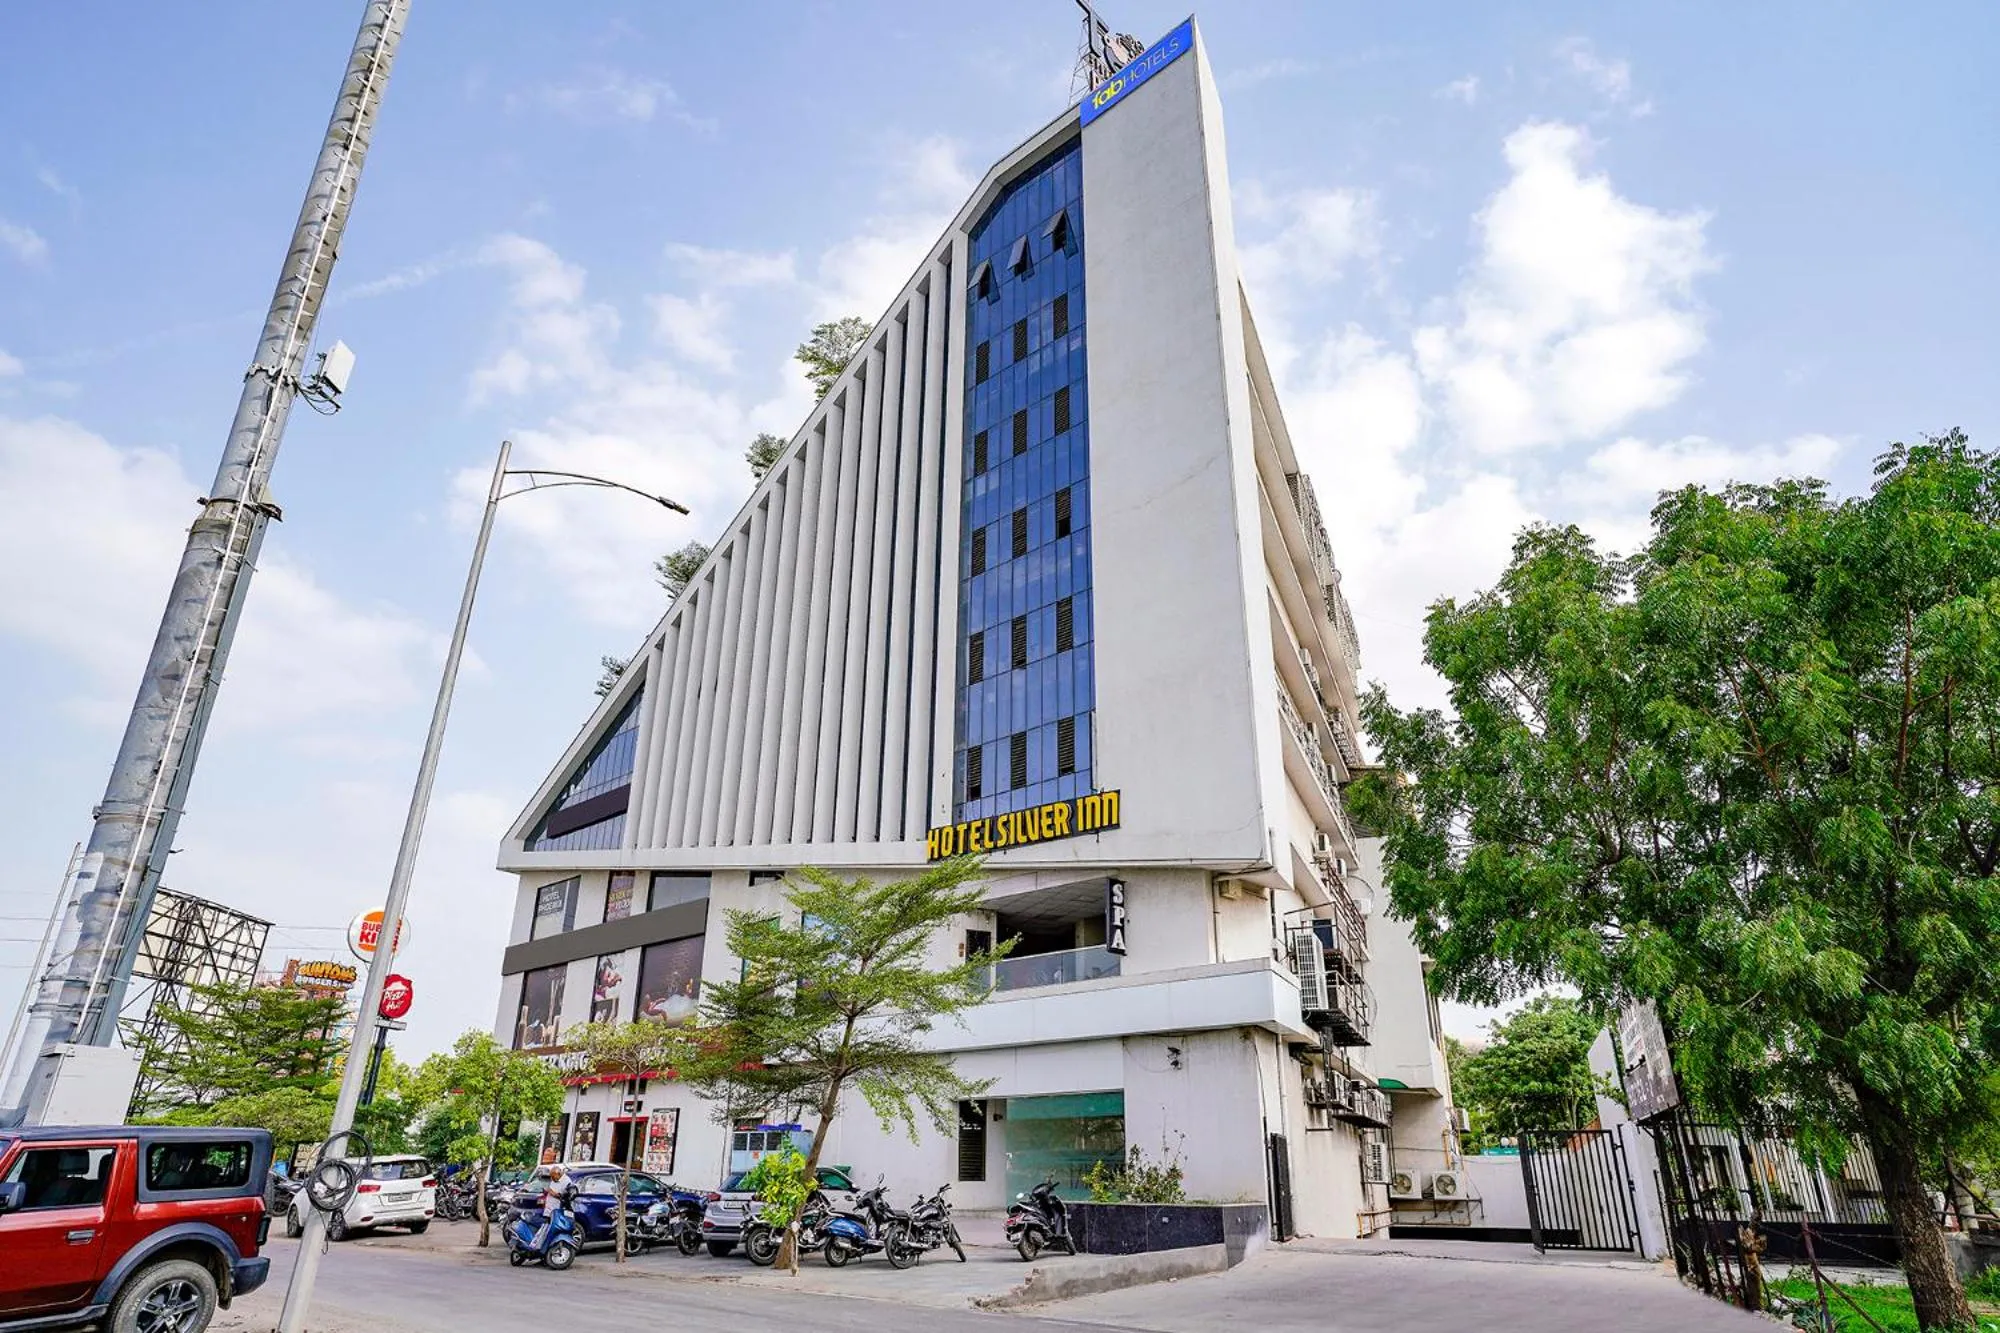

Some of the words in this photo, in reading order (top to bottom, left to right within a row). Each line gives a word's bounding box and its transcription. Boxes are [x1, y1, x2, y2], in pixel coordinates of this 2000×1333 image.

[927, 819, 994, 860] HOTEL
[997, 802, 1073, 847] SILVER
[1111, 883, 1127, 951] SPA
